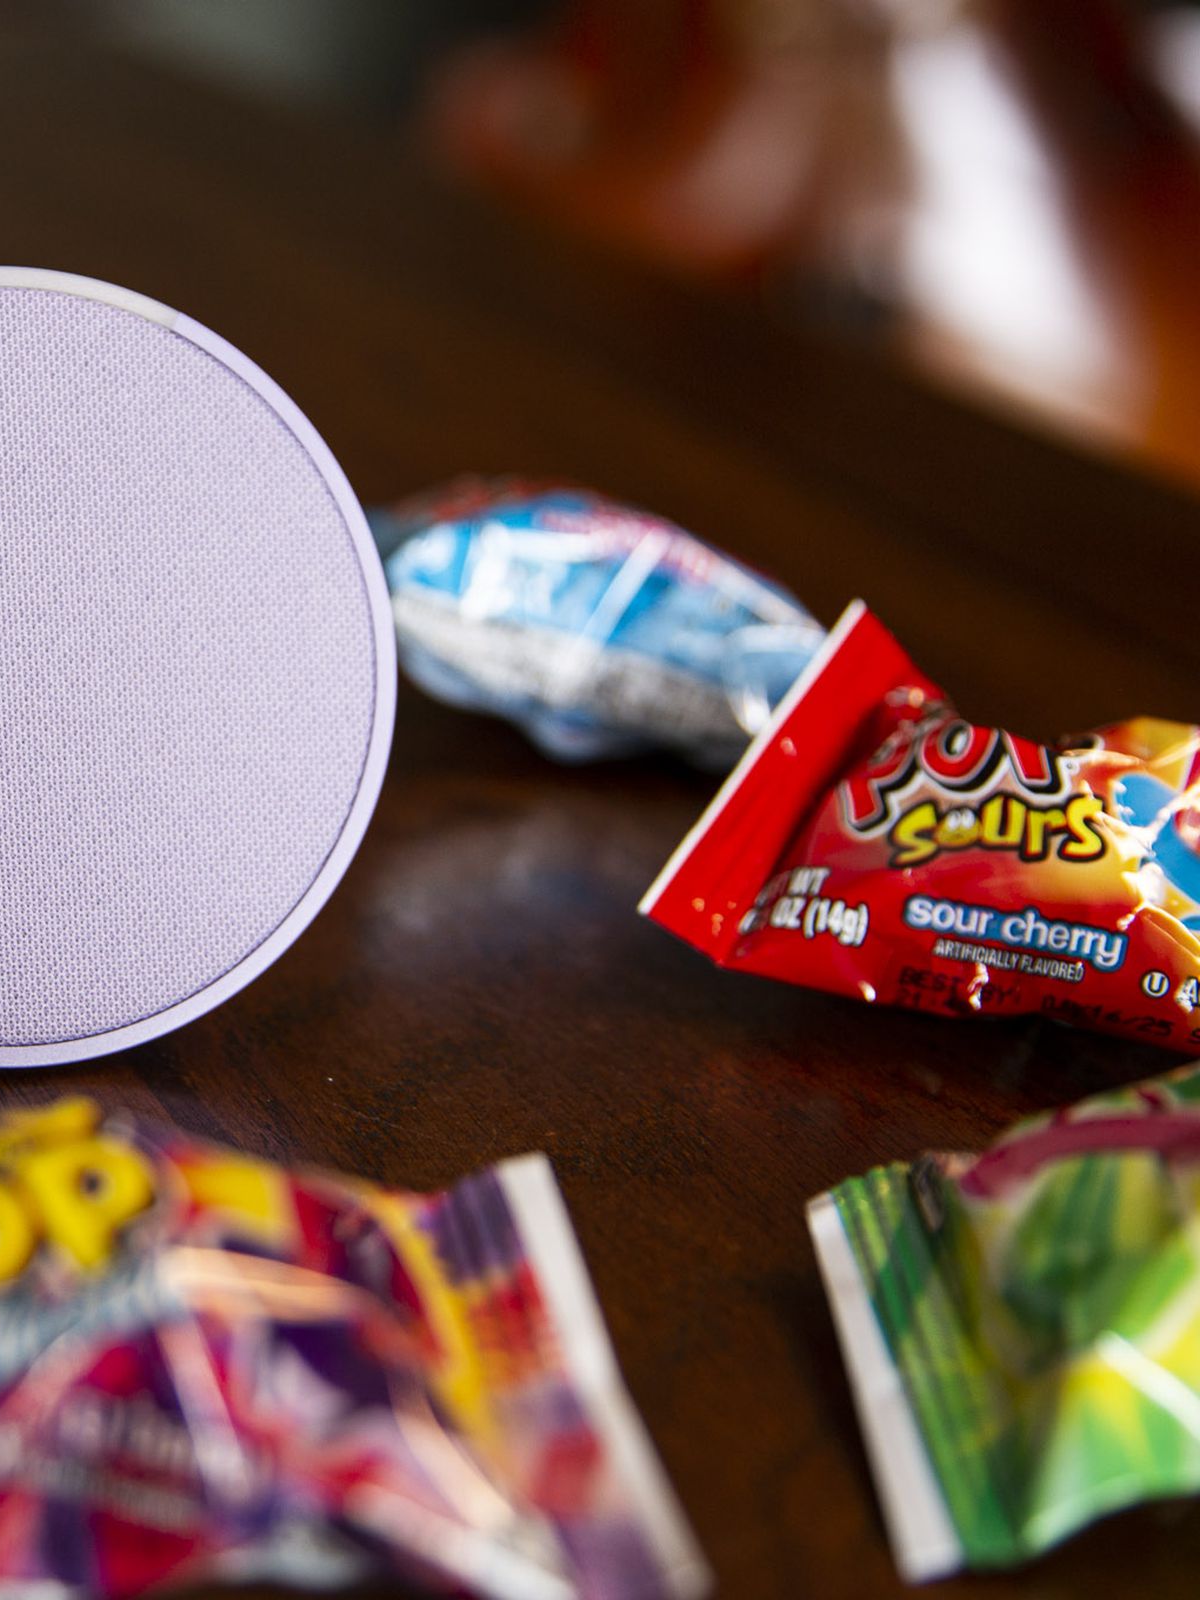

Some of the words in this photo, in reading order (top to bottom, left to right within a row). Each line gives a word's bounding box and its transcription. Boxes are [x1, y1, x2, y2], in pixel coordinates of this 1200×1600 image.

[803, 897, 869, 947] (14g)
[906, 896, 993, 935] sour
[1001, 909, 1124, 968] cherry
[934, 938, 1019, 969] ARTIFICIALLY
[1020, 953, 1085, 982] FLAVORED
